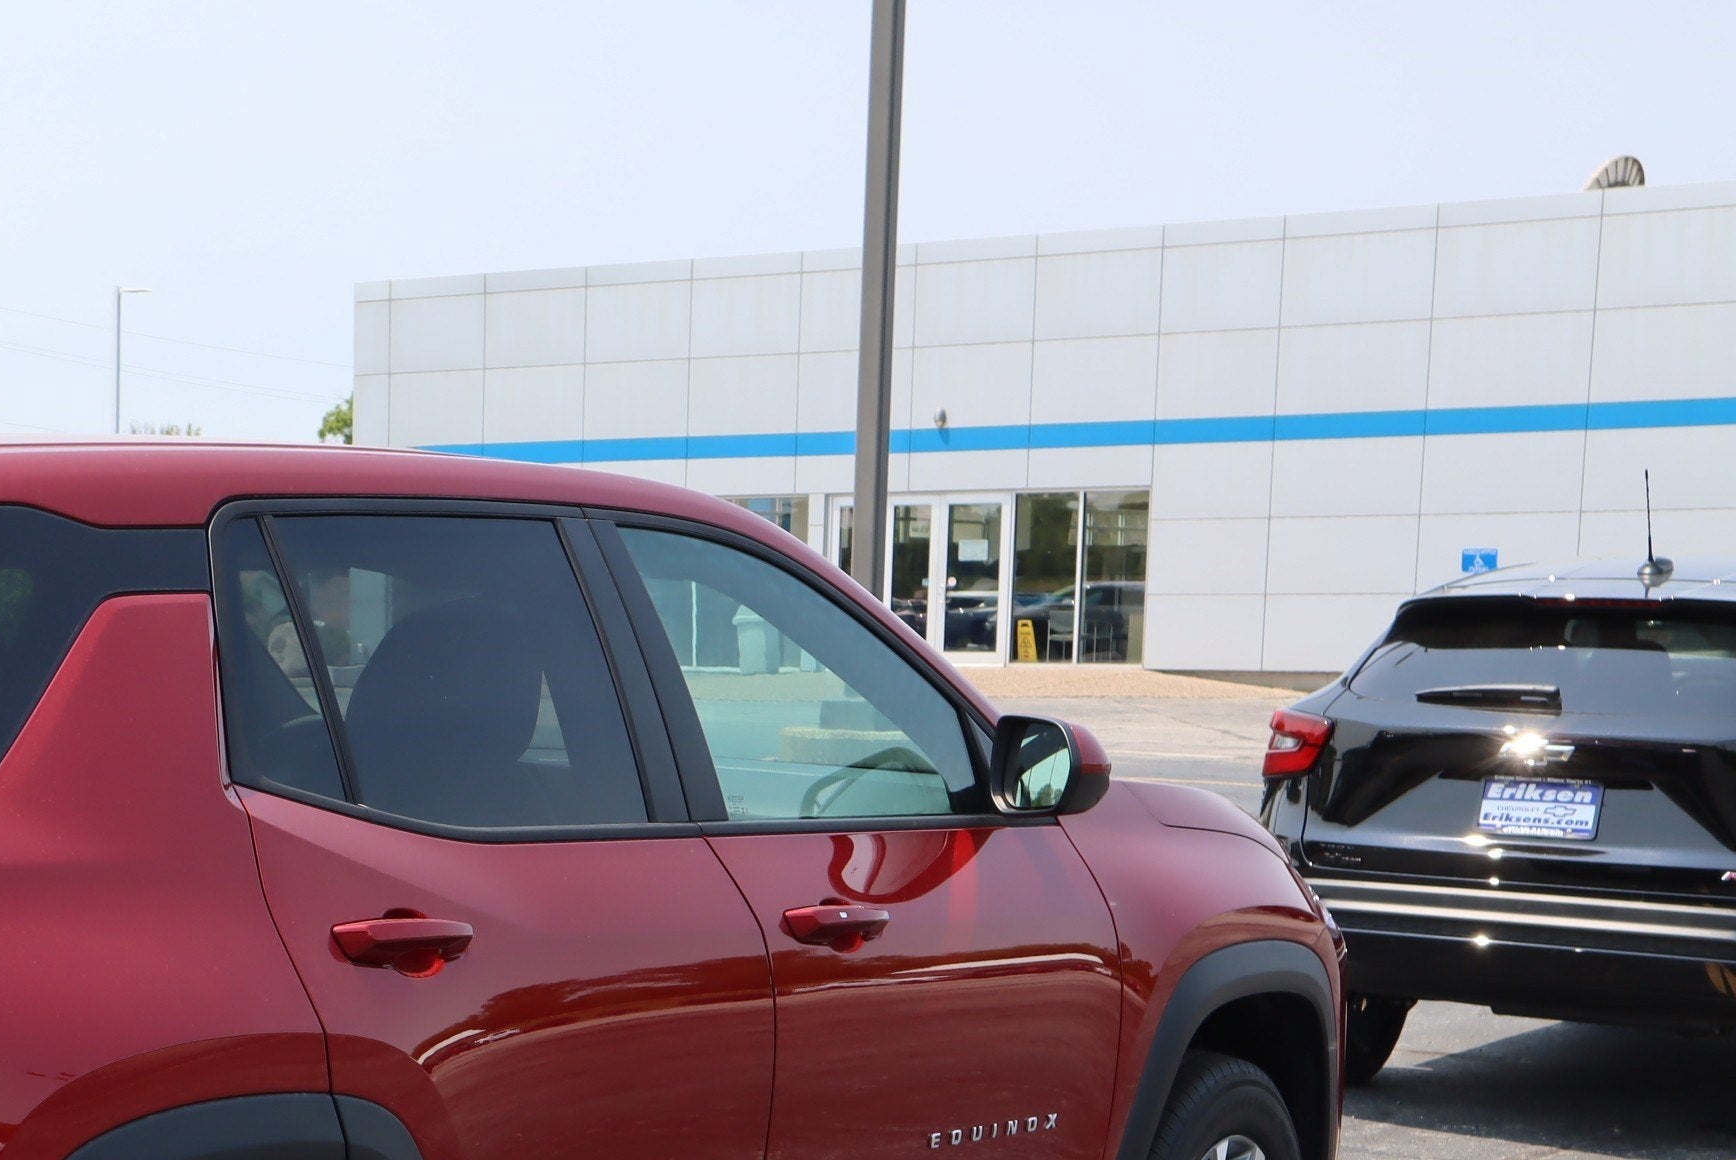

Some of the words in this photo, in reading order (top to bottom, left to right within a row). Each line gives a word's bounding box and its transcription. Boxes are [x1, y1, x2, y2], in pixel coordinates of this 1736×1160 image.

[1487, 783, 1593, 803] Eriksen
[1483, 812, 1589, 826] Eriksens.com
[928, 1113, 1058, 1149] EQUINOX
